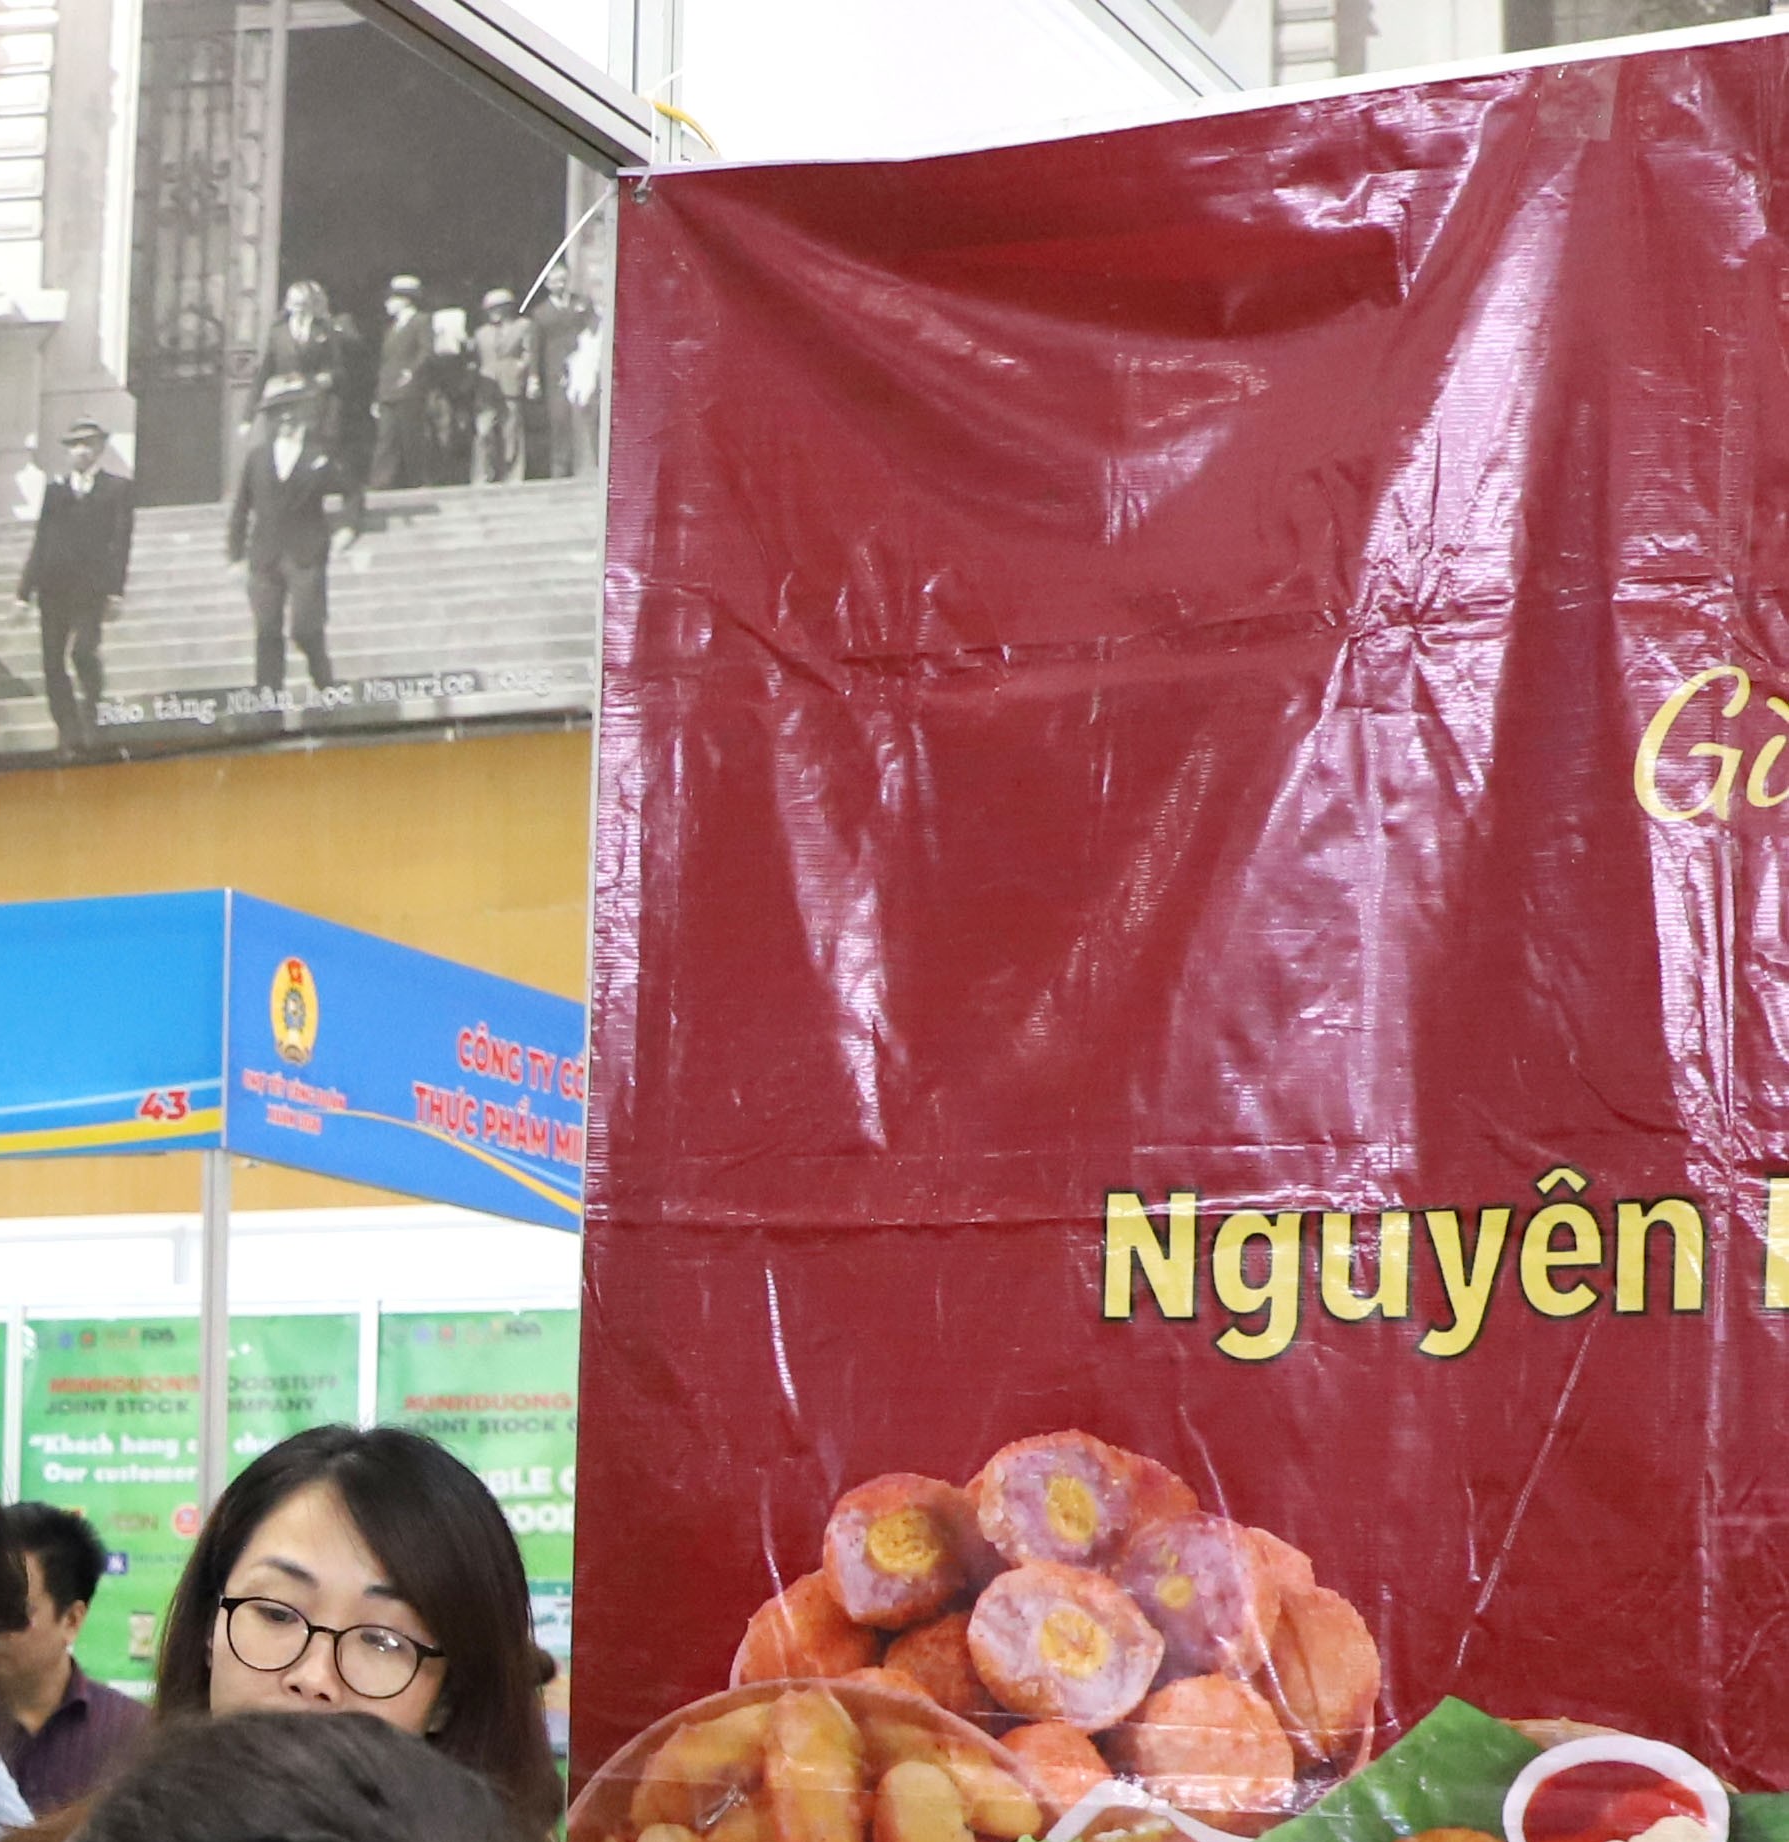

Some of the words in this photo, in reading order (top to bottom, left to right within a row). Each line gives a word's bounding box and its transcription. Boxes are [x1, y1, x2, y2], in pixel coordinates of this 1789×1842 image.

[456, 1020, 523, 1084] CÔNG
[526, 1046, 557, 1093] TY
[136, 1089, 193, 1126] 43
[412, 1080, 478, 1140] THỰC
[1101, 1165, 1706, 1363] Nguyên
